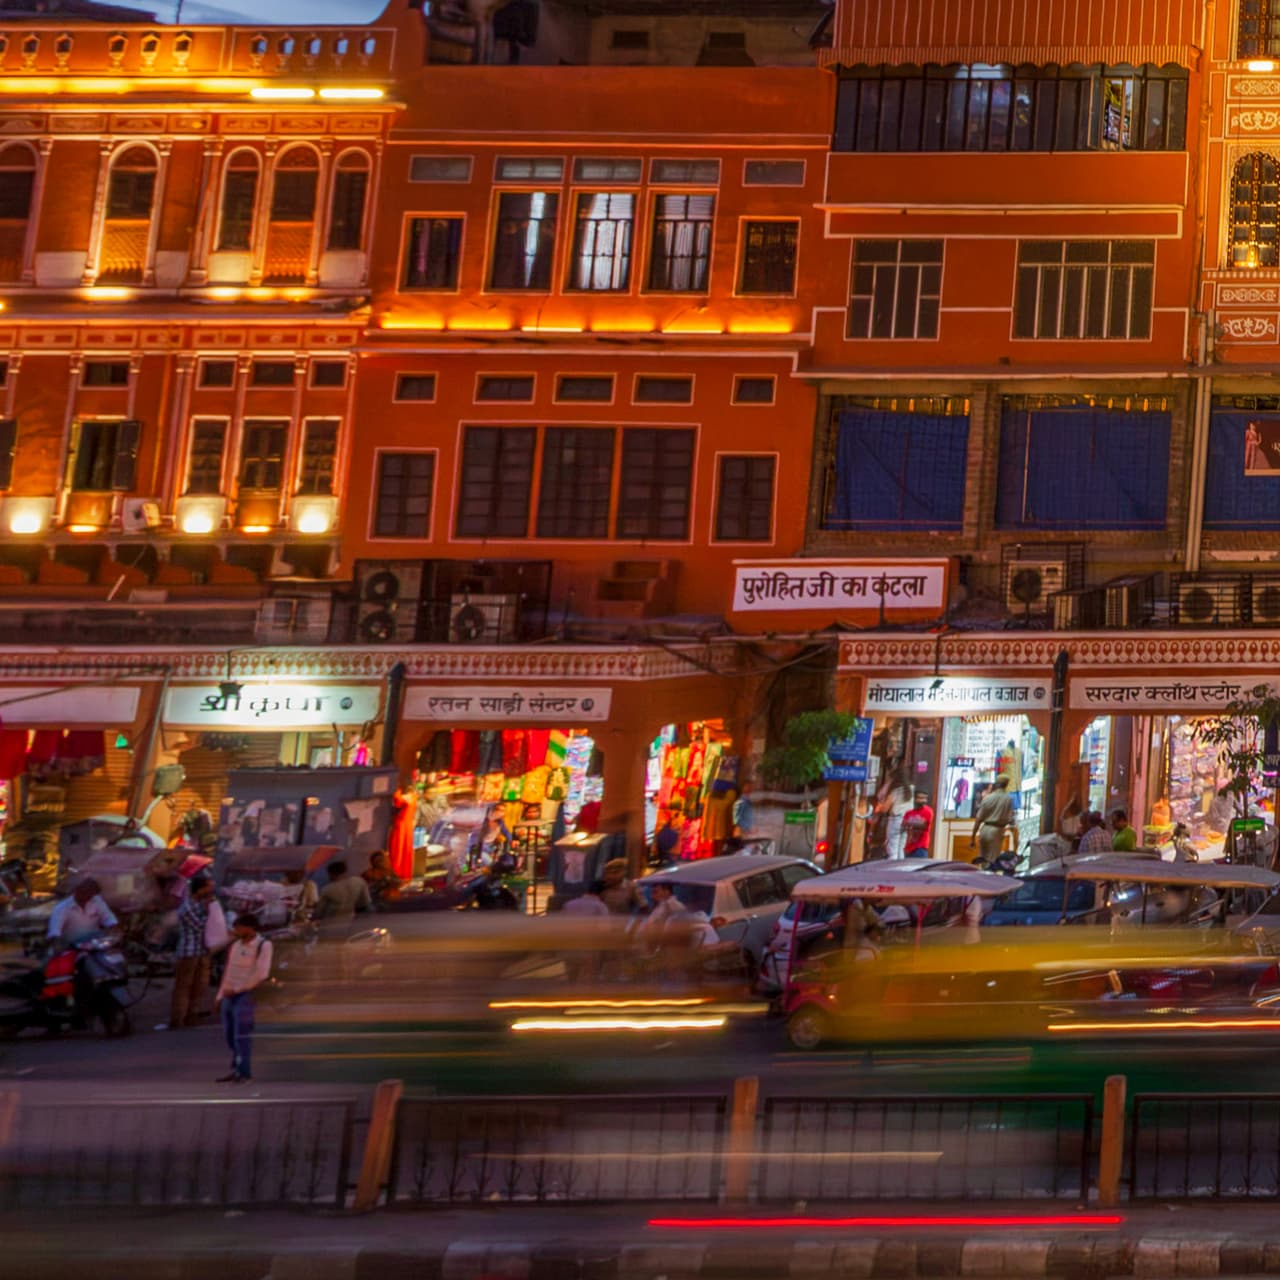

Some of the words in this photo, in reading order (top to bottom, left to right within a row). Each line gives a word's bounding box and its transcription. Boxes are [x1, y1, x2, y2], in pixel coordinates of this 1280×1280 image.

[841, 576, 867, 597] का
[994, 685, 1031, 703] बजाज
[1085, 686, 1143, 704] सरदार
[1200, 681, 1242, 702] स्टोर
[428, 696, 472, 713] रतन
[479, 693, 524, 715] साड़ी
